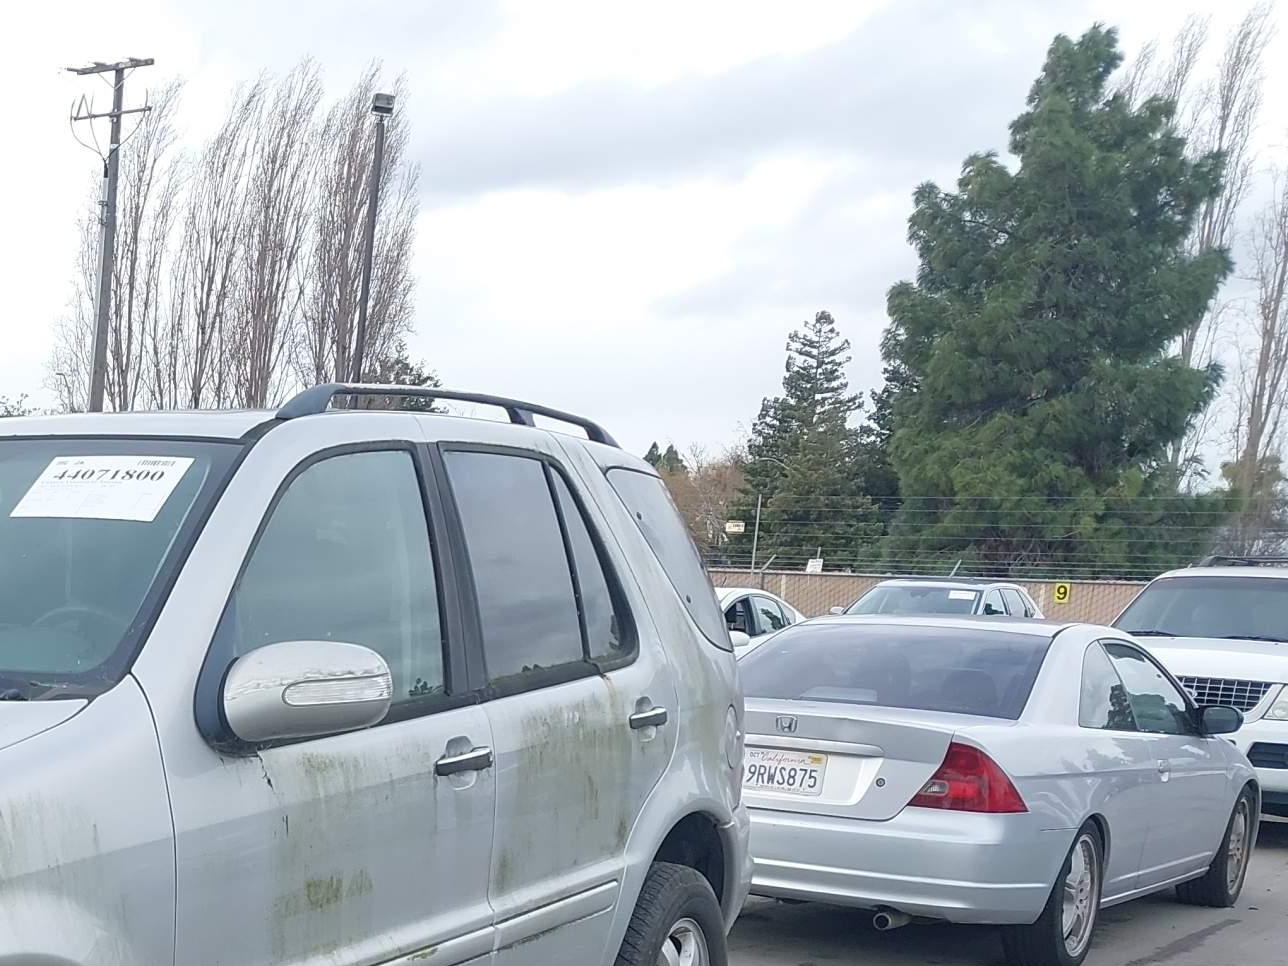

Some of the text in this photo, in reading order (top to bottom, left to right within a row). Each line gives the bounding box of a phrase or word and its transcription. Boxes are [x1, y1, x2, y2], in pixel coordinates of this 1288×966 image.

[54, 469, 165, 481] 44071800
[1056, 585, 1068, 600] 9
[761, 752, 808, 765] California
[746, 764, 818, 789] 9RWS875
